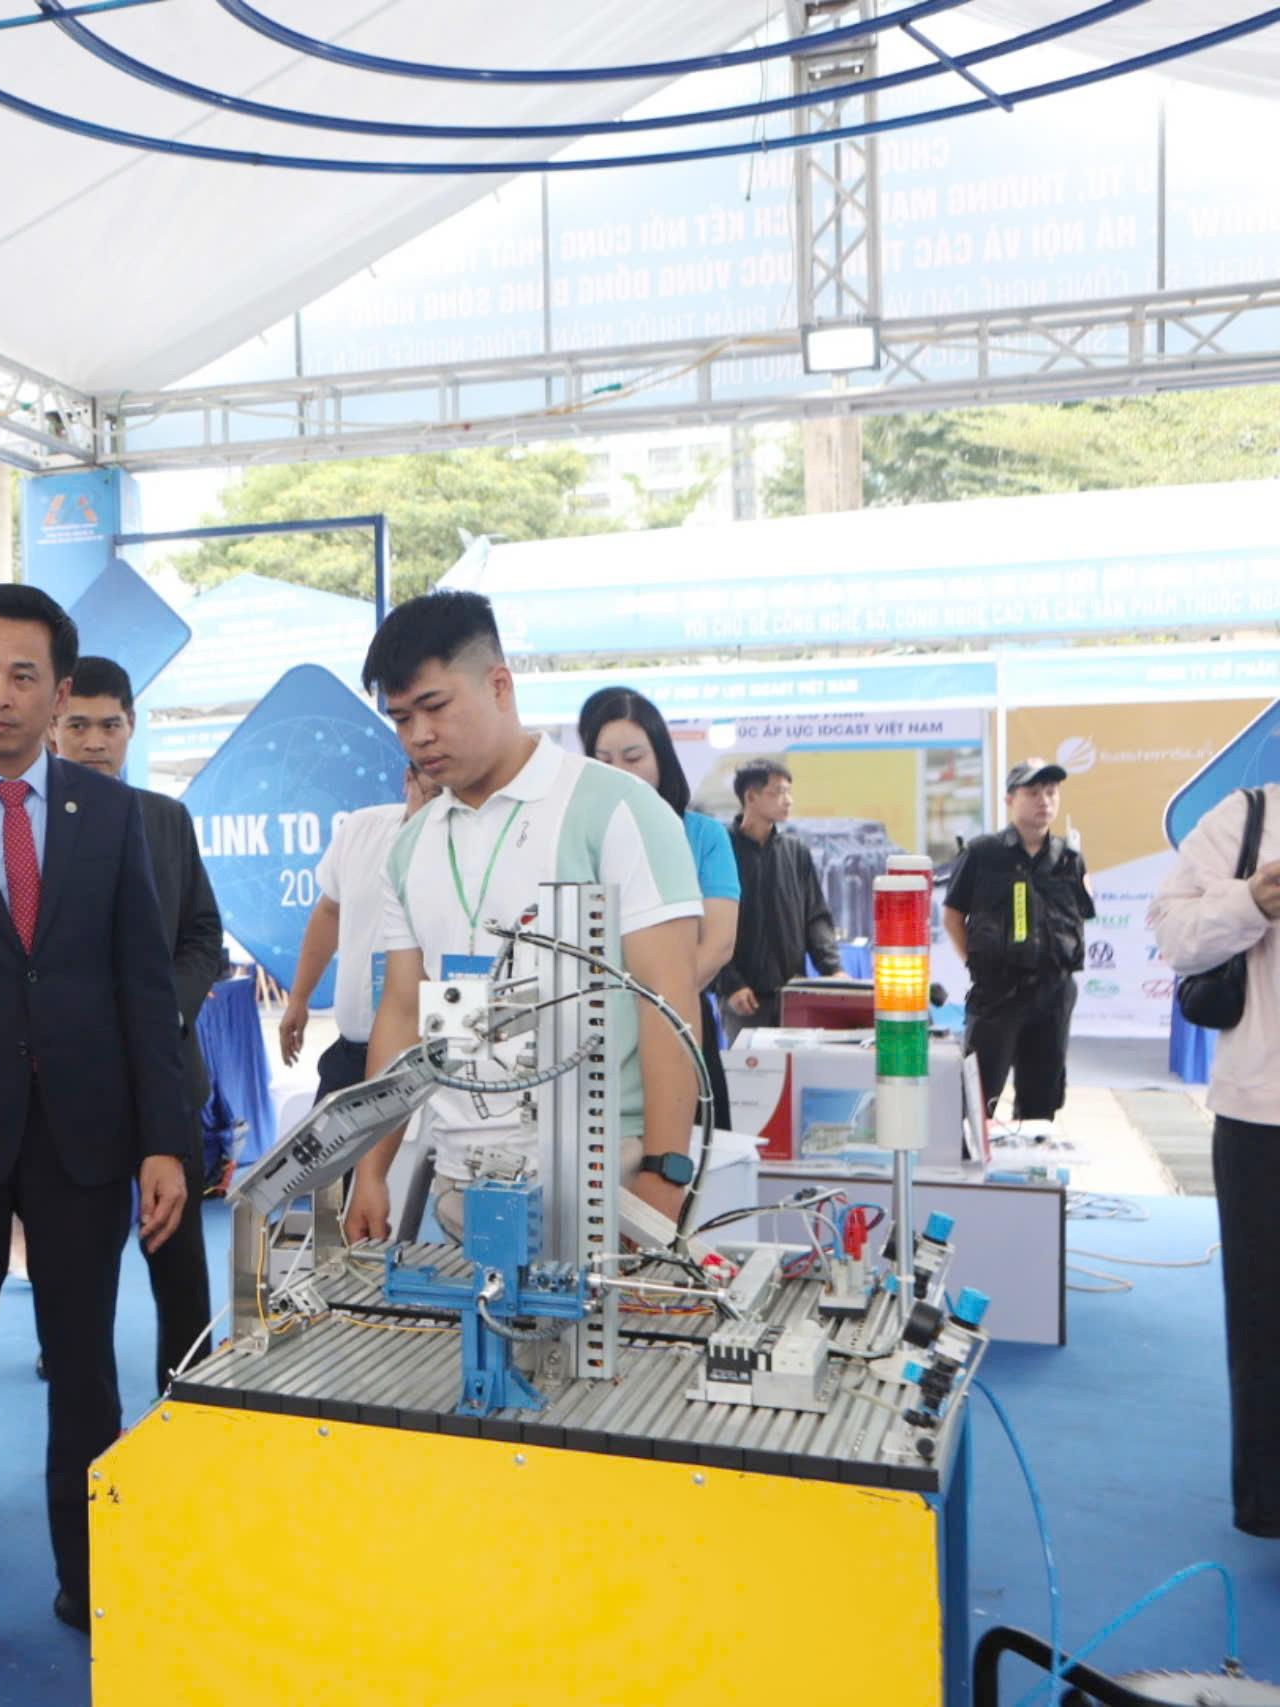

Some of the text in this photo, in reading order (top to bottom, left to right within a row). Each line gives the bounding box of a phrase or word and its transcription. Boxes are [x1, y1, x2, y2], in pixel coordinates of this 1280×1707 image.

[817, 723, 870, 737] IDCAST
[875, 720, 903, 738] VIỆT
[907, 721, 944, 735] NAM
[195, 813, 270, 858] LINK
[278, 811, 320, 855] TO
[279, 868, 321, 908] 20
